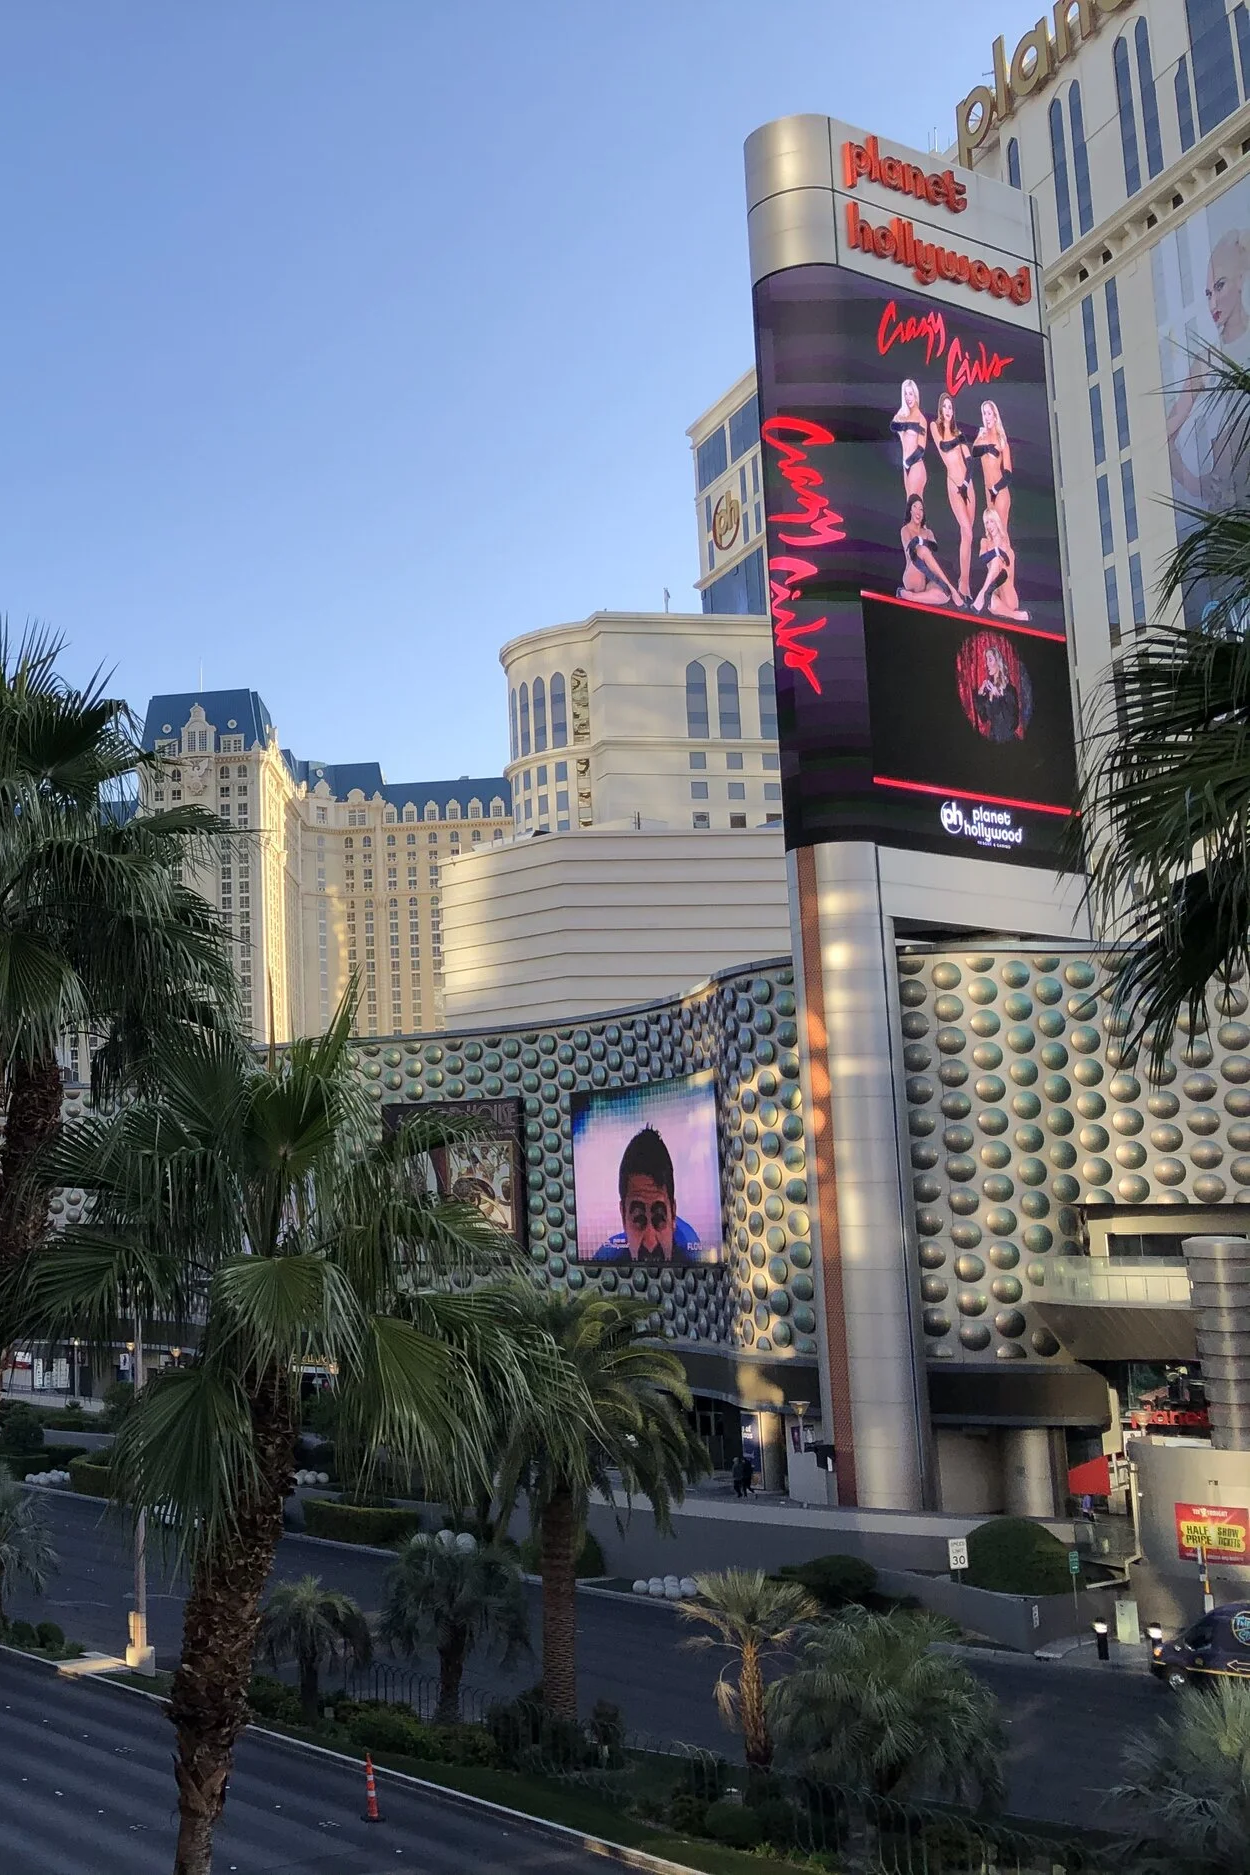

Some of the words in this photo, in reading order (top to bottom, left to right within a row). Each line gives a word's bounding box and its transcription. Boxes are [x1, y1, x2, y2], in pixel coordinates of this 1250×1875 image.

[956, 0, 1124, 171] plan
[843, 136, 967, 214] planet
[848, 202, 1033, 306] hollywood
[878, 301, 946, 364] Crazy
[947, 337, 1015, 397] Girls
[941, 801, 963, 833] ph
[972, 806, 1011, 826] planet
[964, 820, 1023, 843] hollywood
[1186, 1525, 1208, 1535] HALF
[1186, 1535, 1213, 1546] PRICE
[1217, 1527, 1240, 1538] SHOW
[1218, 1537, 1241, 1548] TICKETS
[952, 1555, 966, 1566] 30
